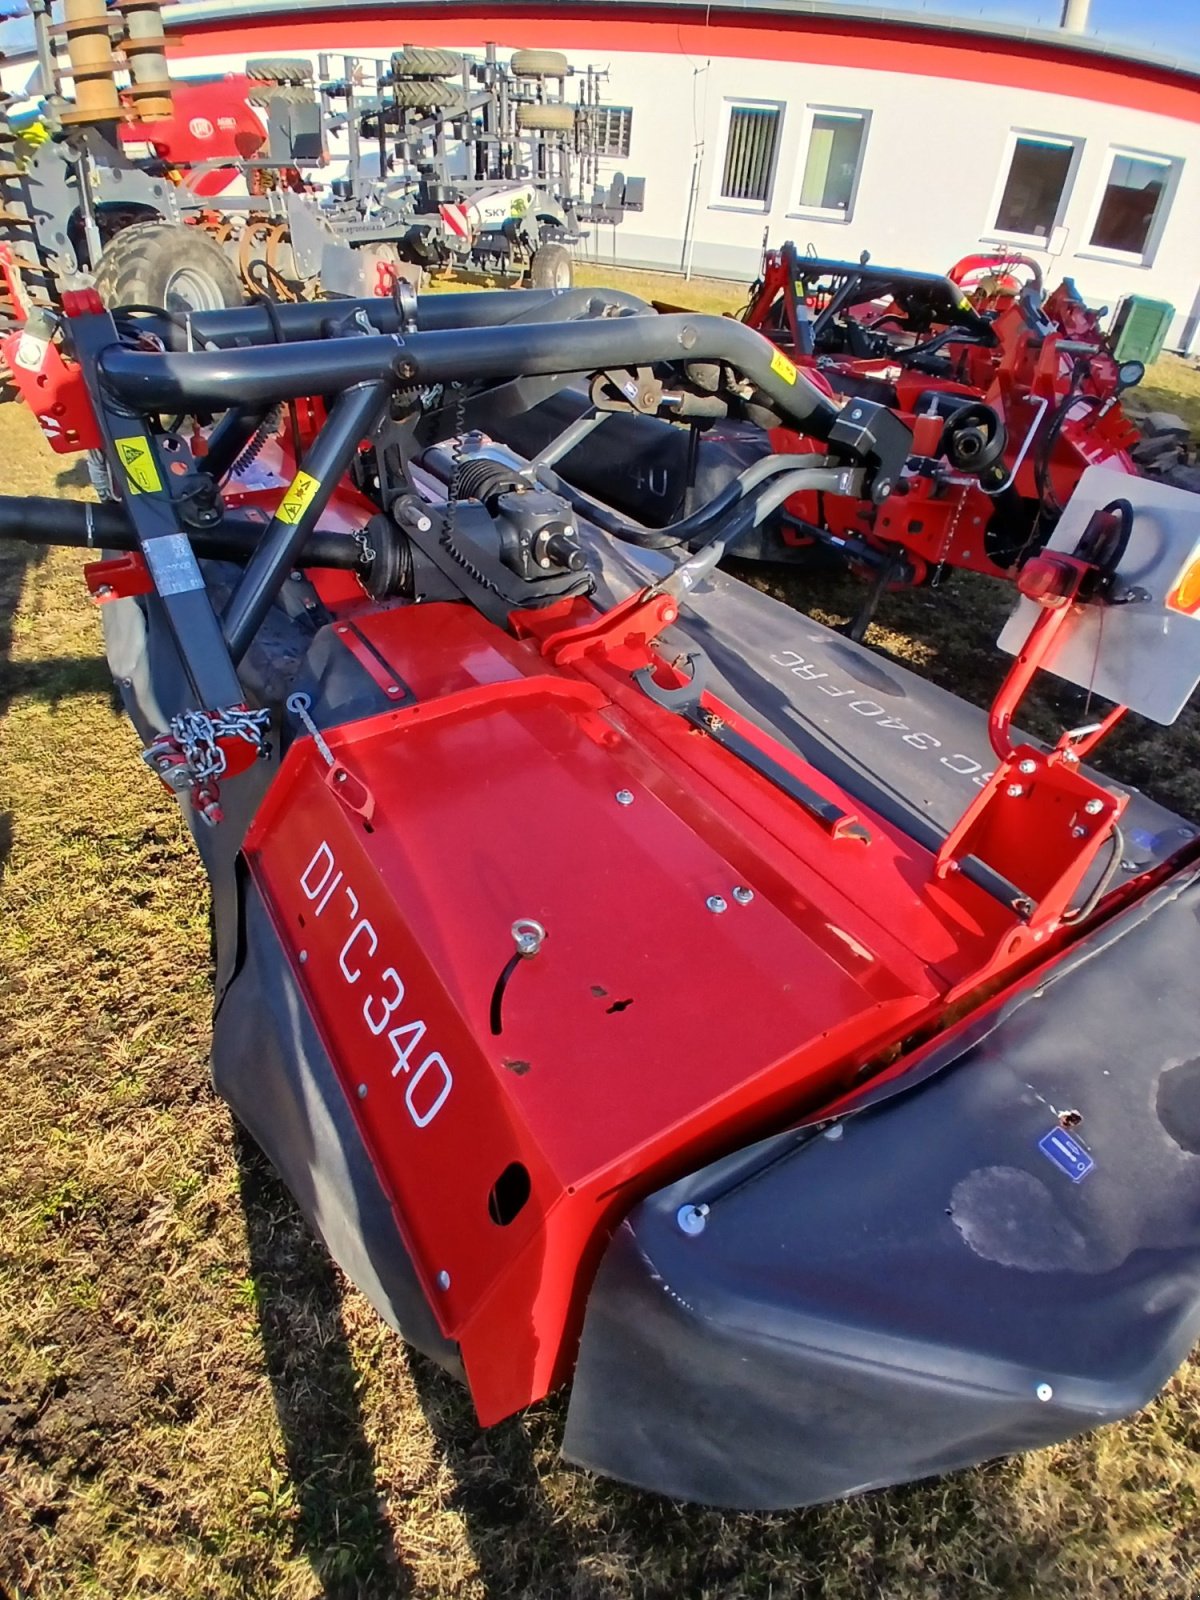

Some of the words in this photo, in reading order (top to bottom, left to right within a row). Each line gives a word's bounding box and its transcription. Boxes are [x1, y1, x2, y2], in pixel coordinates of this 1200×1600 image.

[485, 208, 506, 217] SKY
[769, 650, 828, 680] RC
[848, 700, 942, 750] 340
[362, 967, 454, 1128] 340
